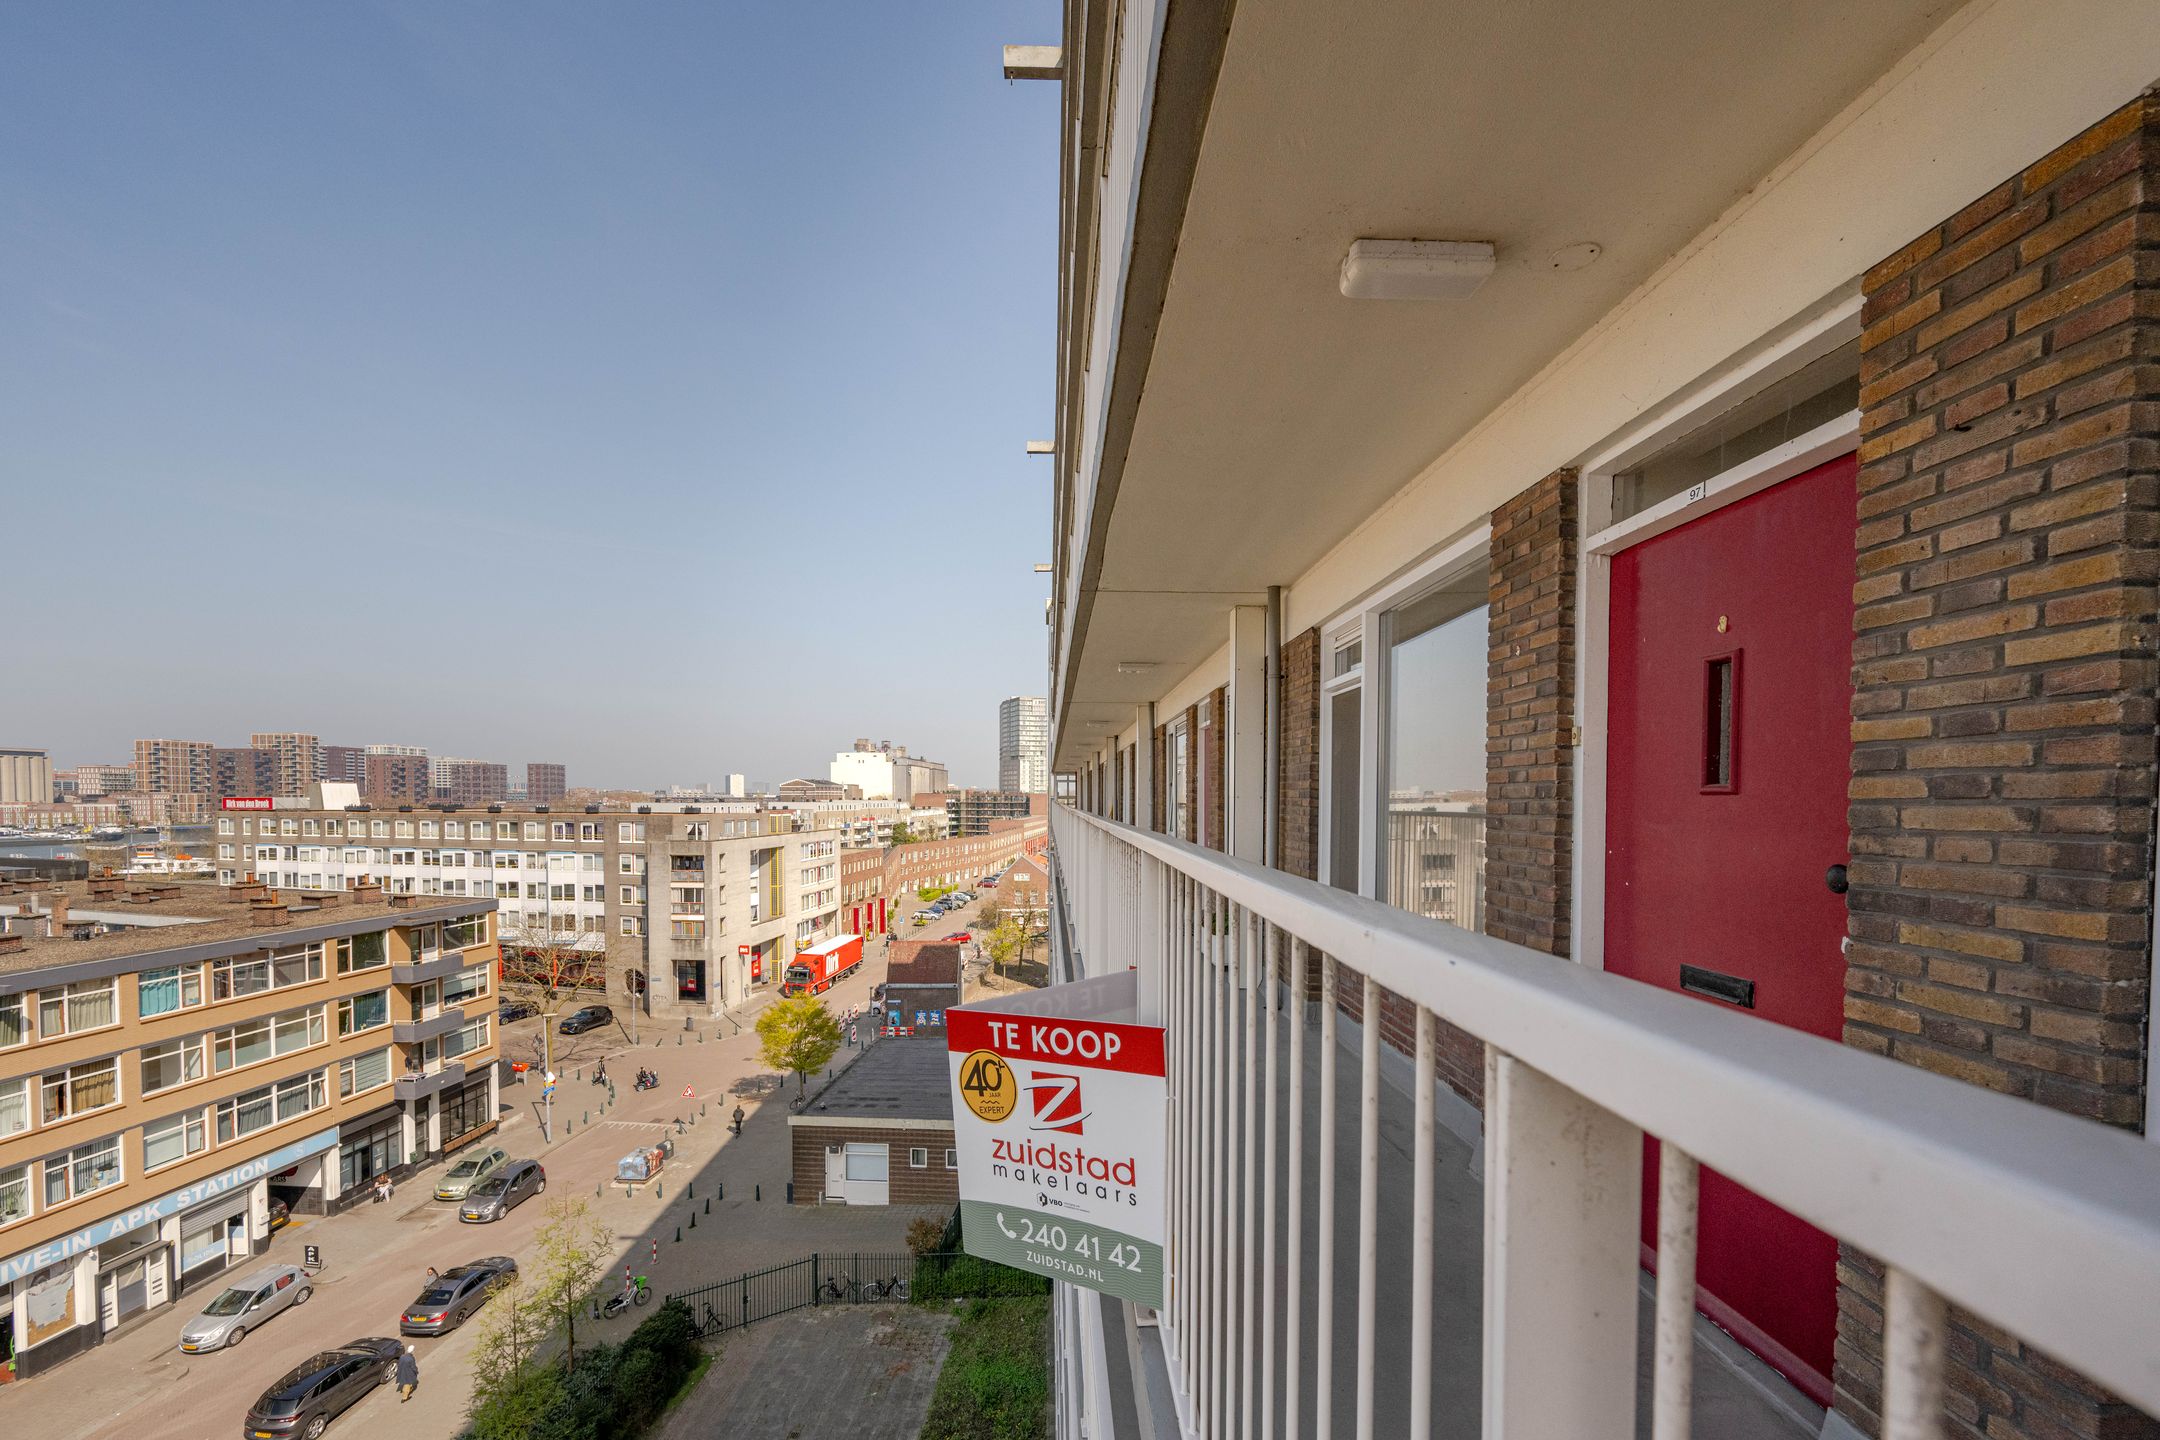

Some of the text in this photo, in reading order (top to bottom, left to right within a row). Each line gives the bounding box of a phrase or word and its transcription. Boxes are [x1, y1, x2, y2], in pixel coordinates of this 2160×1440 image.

[1689, 486, 1701, 500] 97
[826, 952, 839, 977] Dirk
[988, 1021, 1121, 1060] TE KOOP
[979, 1105, 1005, 1115] EXPERT
[991, 1138, 1137, 1188] zuidstad
[109, 1202, 162, 1238] APK
[176, 1158, 269, 1208] STATION
[993, 1163, 1137, 1206] makelaars
[1049, 1198, 1063, 1207] VBO
[307, 1246, 315, 1262] APK
[1020, 1219, 1142, 1273] 240 41 42
[1026, 1250, 1104, 1283] ZUIDSTAD.NL
